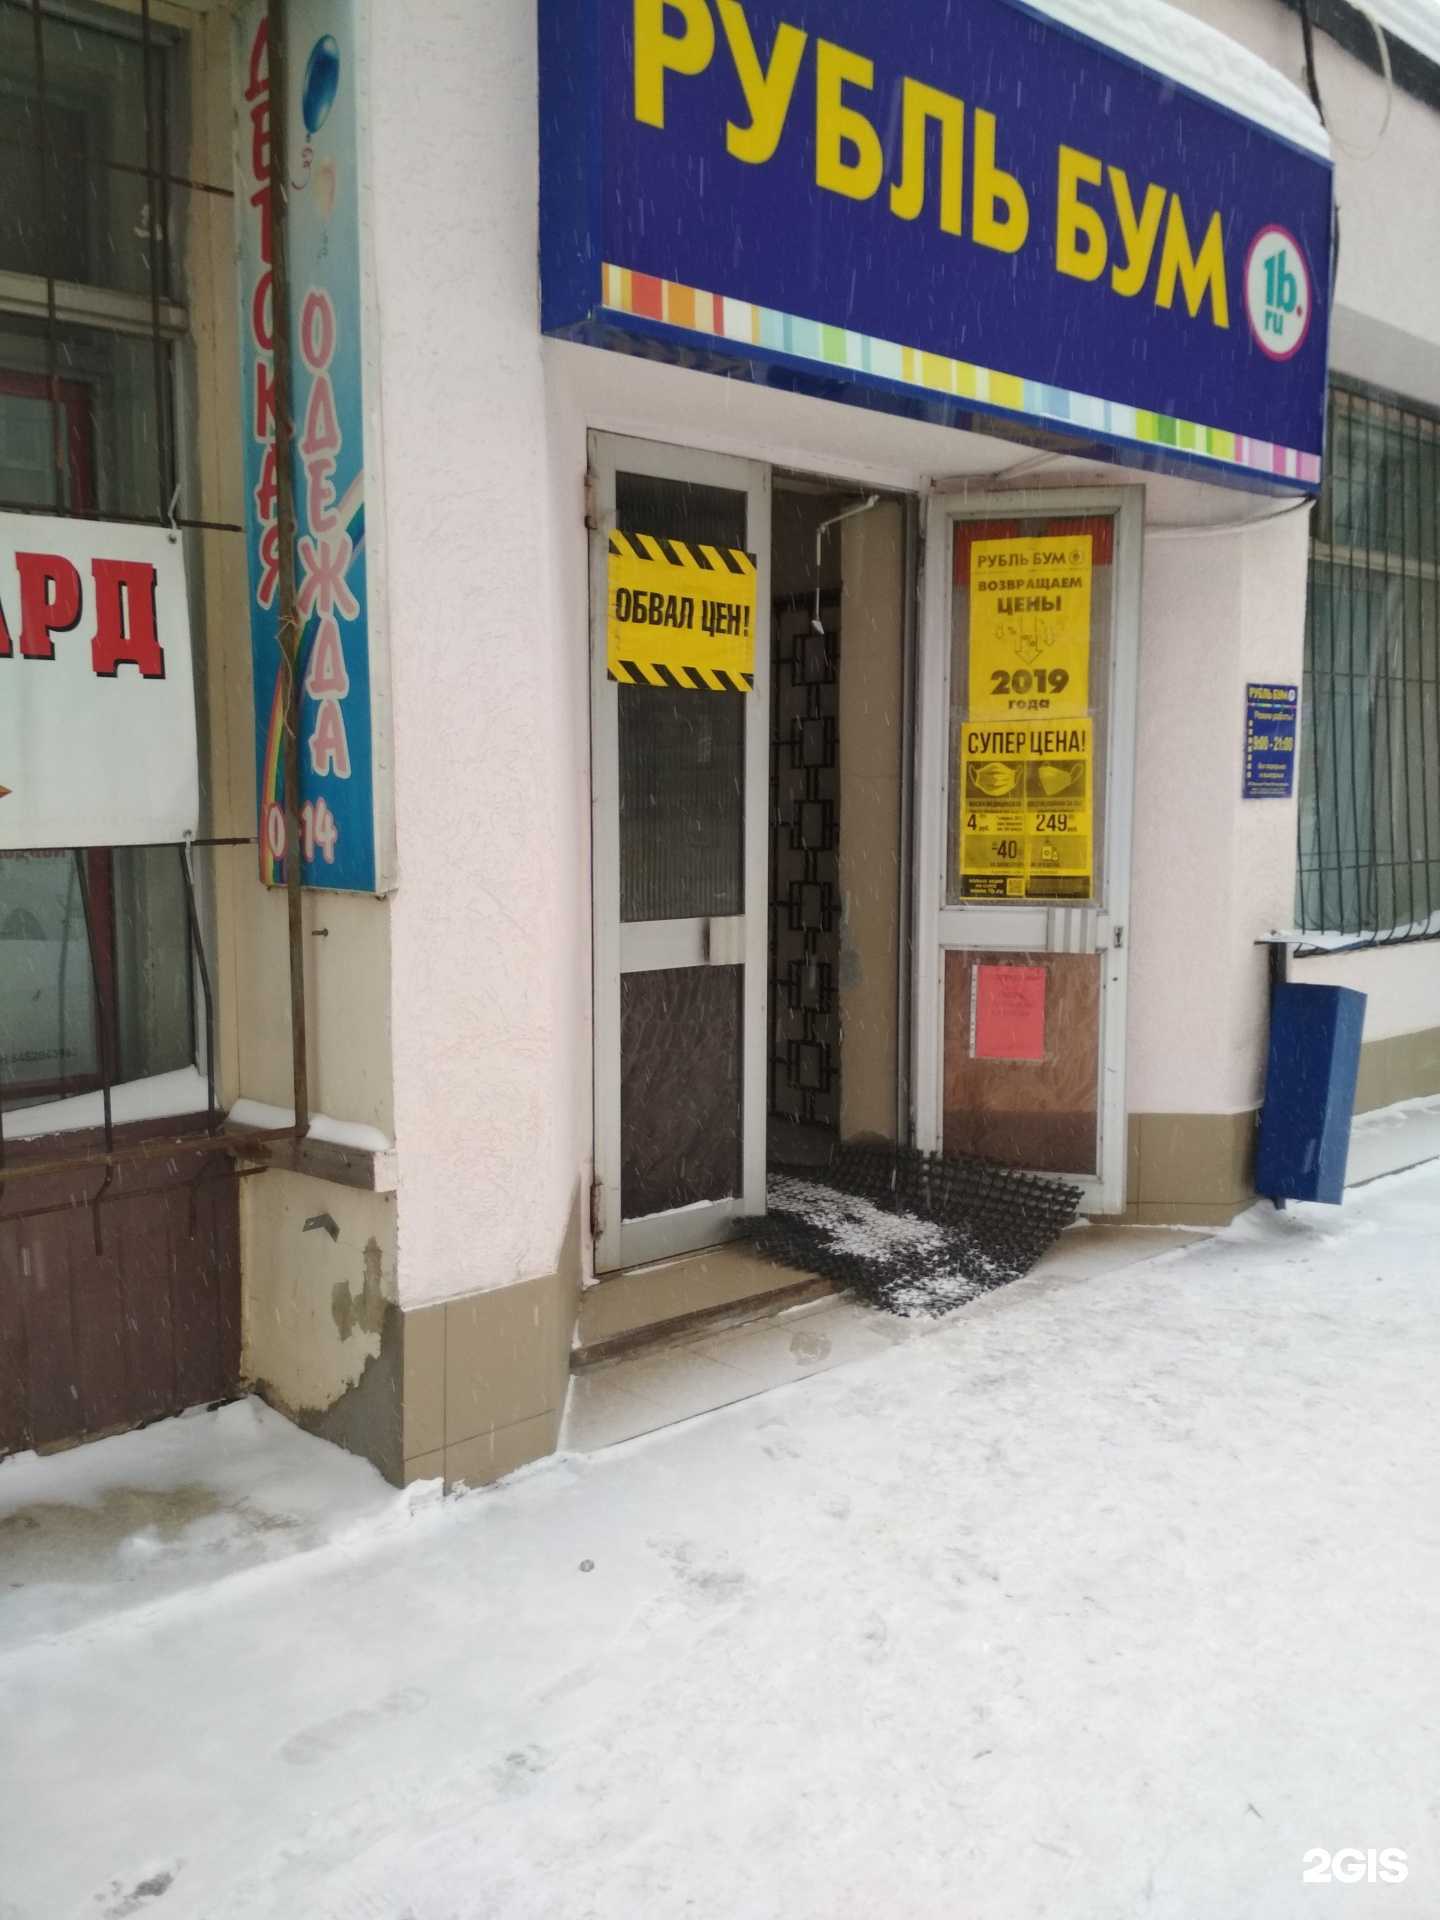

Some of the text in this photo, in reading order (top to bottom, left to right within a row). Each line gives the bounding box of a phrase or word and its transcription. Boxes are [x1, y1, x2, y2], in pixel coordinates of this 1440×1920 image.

[634, 0, 1230, 330] РУБЛЬ БУМ
[298, 287, 360, 780] ОДЕЖДА
[977, 553, 1029, 569] РУБЛЬ
[1032, 552, 1067, 567] БУМ
[977, 576, 1083, 592] ВОЗВРАЩАЕМ
[0, 550, 166, 681] РД
[615, 587, 751, 638] ОБВАЛ ЦЕН!
[997, 595, 1062, 616] ЦЕНЫ
[990, 668, 1070, 696] 2019
[1008, 698, 1050, 711] года
[967, 730, 1087, 756] СУПЕР ЦЕНА!
[967, 813, 977, 831] 4
[1036, 813, 1068, 832] 249
